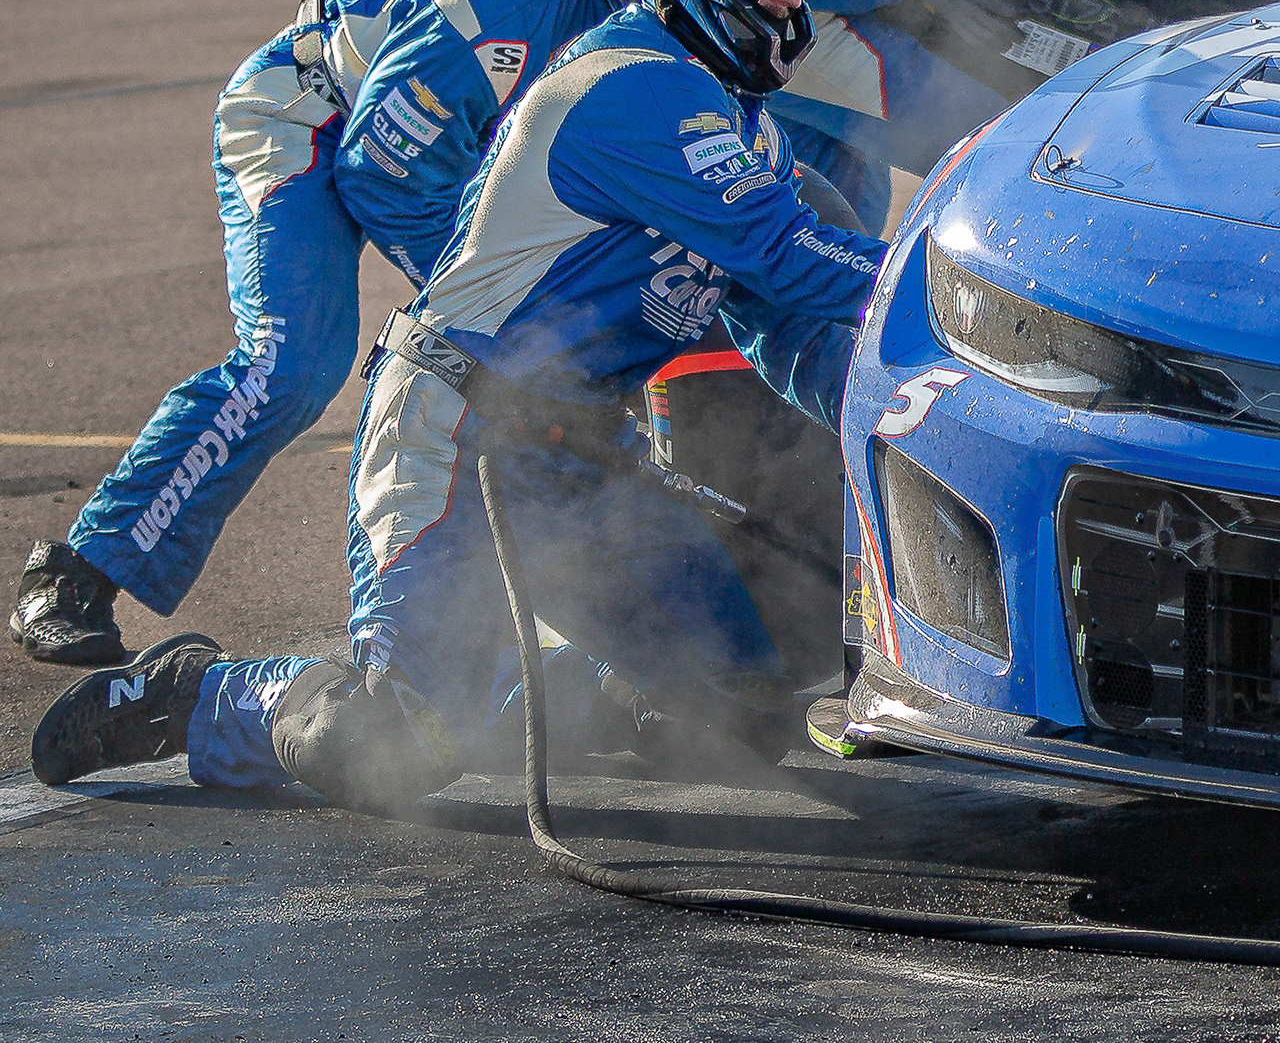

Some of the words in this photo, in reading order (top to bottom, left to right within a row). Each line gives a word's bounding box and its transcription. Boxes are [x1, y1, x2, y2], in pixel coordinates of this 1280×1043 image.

[390, 99, 430, 136] SIEMENS
[695, 141, 742, 161] SIEMENS
[432, 365, 459, 387] WEAR
[873, 367, 974, 439] 5
